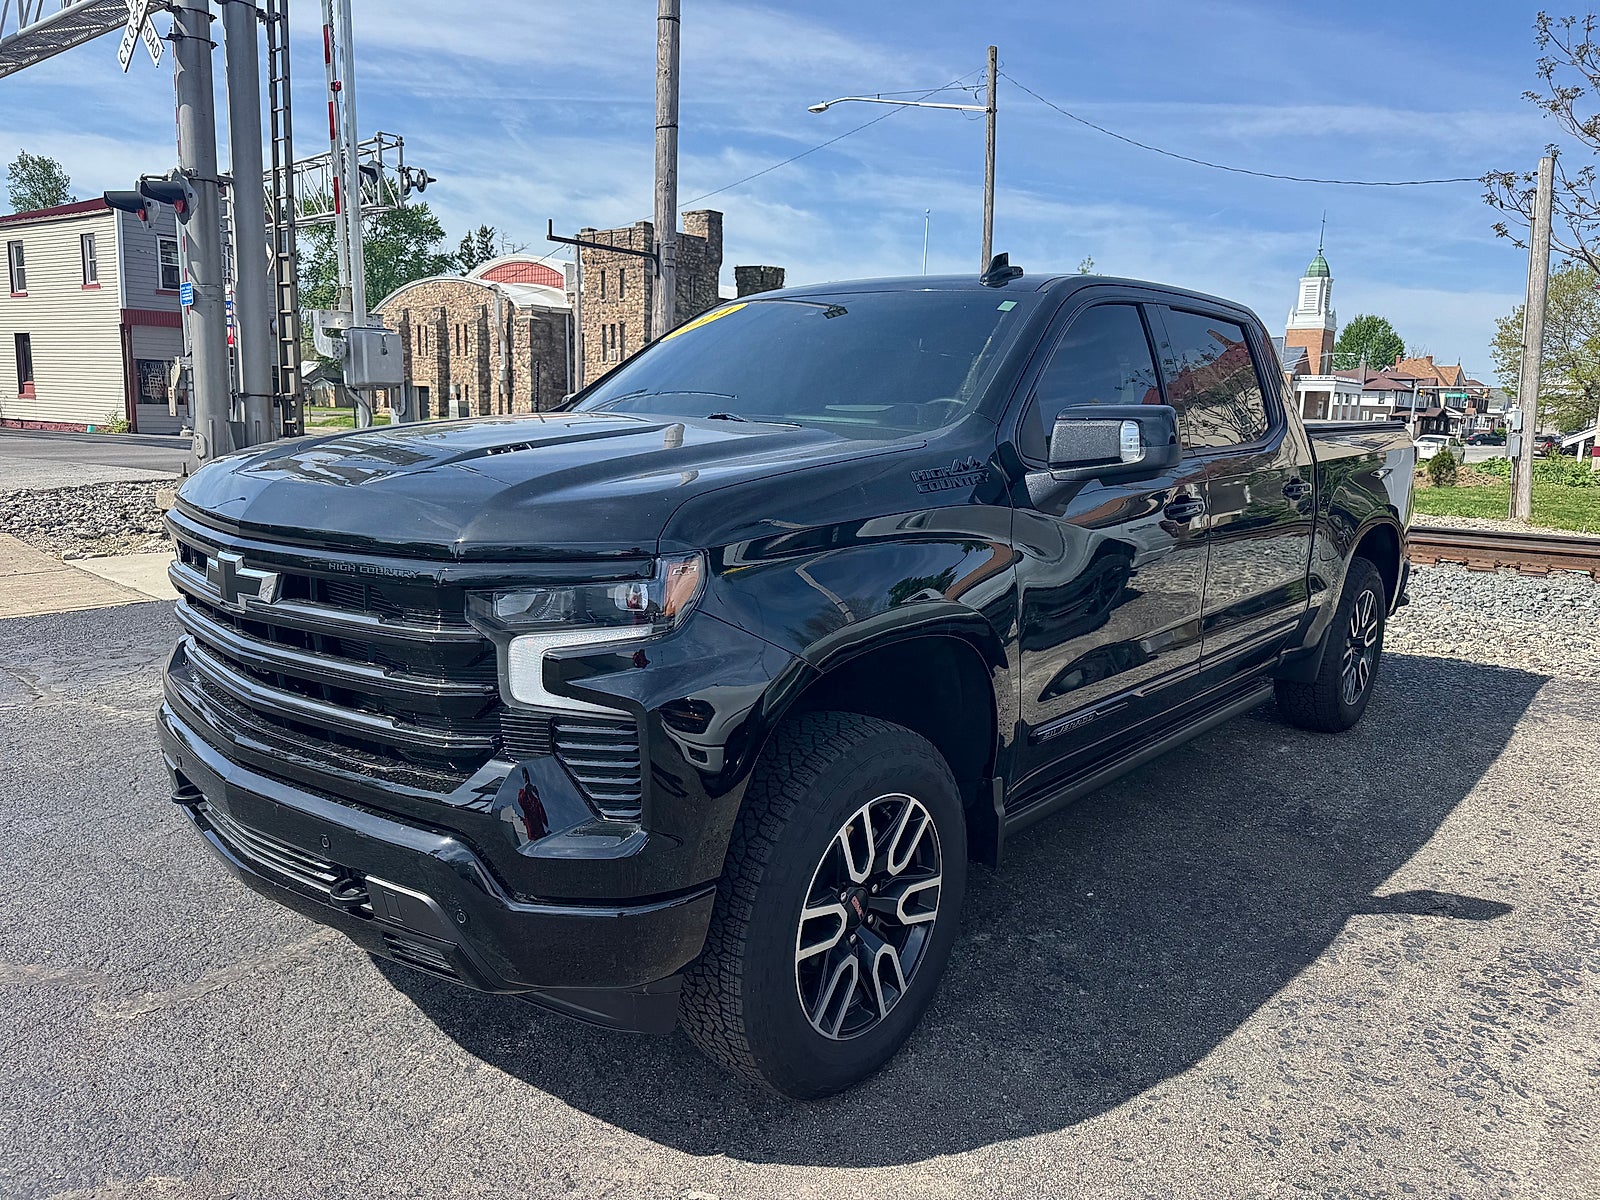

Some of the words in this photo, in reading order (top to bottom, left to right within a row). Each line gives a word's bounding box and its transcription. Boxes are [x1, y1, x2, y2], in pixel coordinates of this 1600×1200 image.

[910, 465, 953, 482] HIGH
[916, 472, 989, 494] COUNTRY
[328, 561, 356, 572] HIGH
[359, 565, 420, 578] COUNTRY
